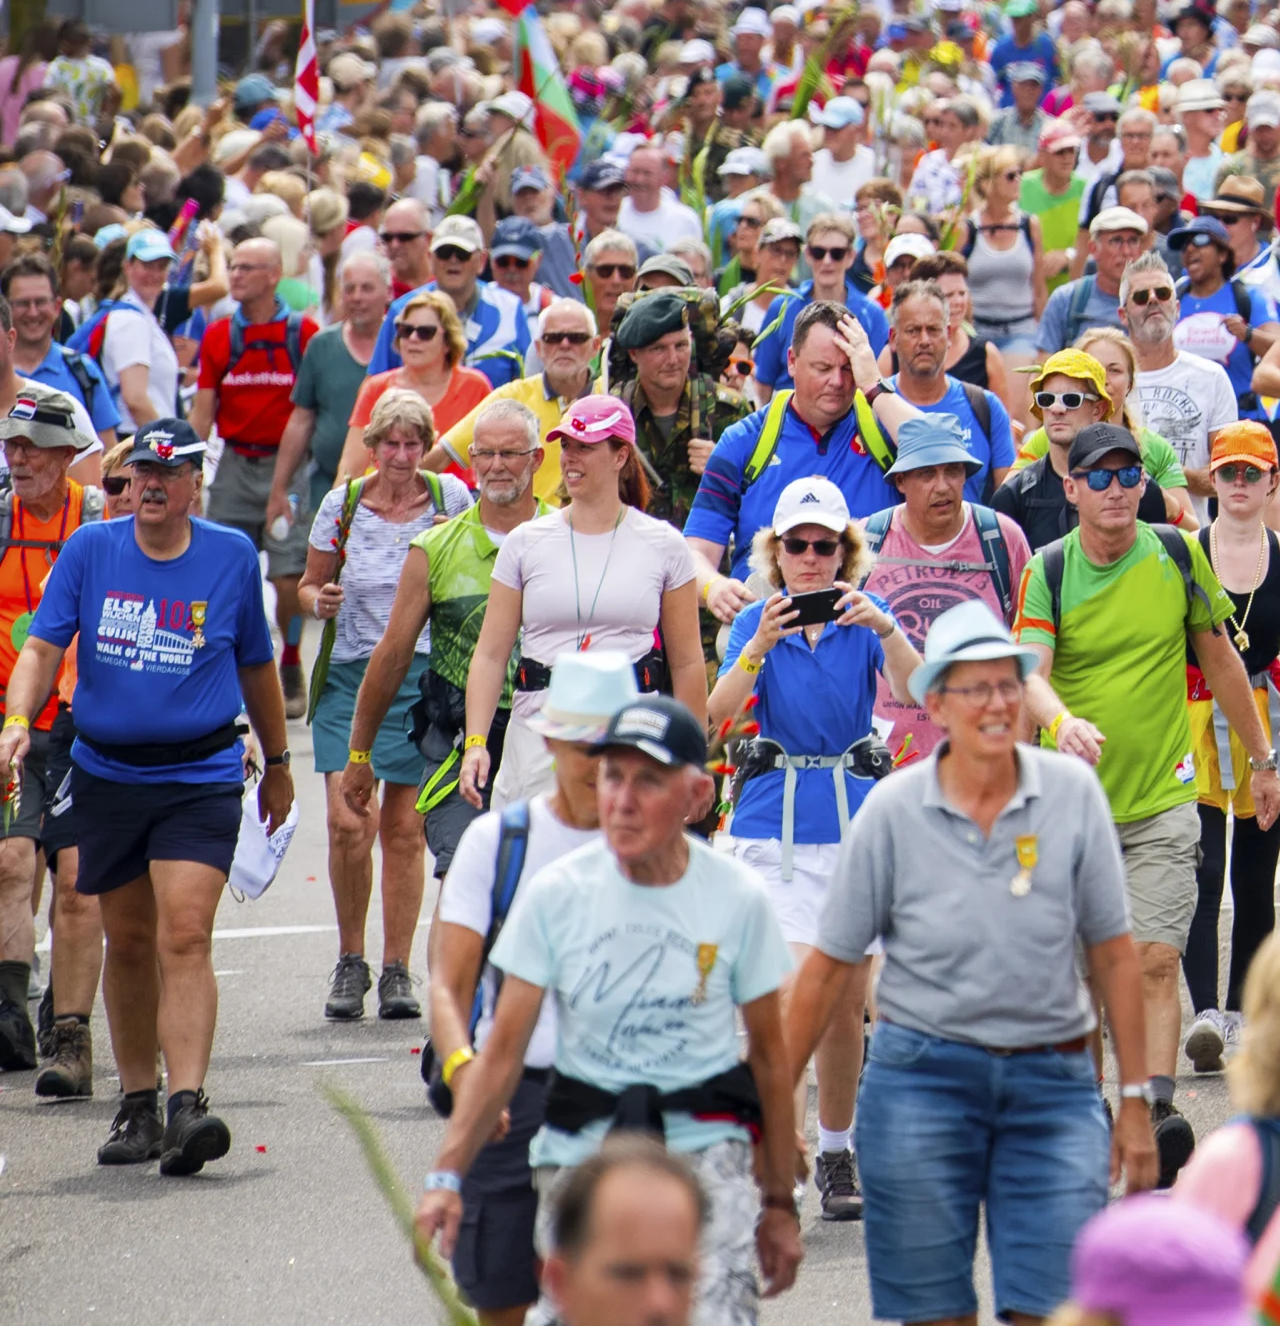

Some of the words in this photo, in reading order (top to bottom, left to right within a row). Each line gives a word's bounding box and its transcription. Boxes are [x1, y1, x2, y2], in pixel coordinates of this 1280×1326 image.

[102, 597, 145, 614] ELST
[918, 597, 943, 610] OIL
[101, 608, 141, 624] WIJCHEN
[97, 625, 139, 642] CUIJK
[95, 653, 129, 669] NIJMEGEN
[96, 641, 123, 656] WALK
[124, 646, 139, 659] OF
[139, 650, 158, 663] THE
[159, 652, 193, 666] WORLD
[145, 664, 191, 676] VIERDAAGSE
[906, 701, 924, 711] MAD
